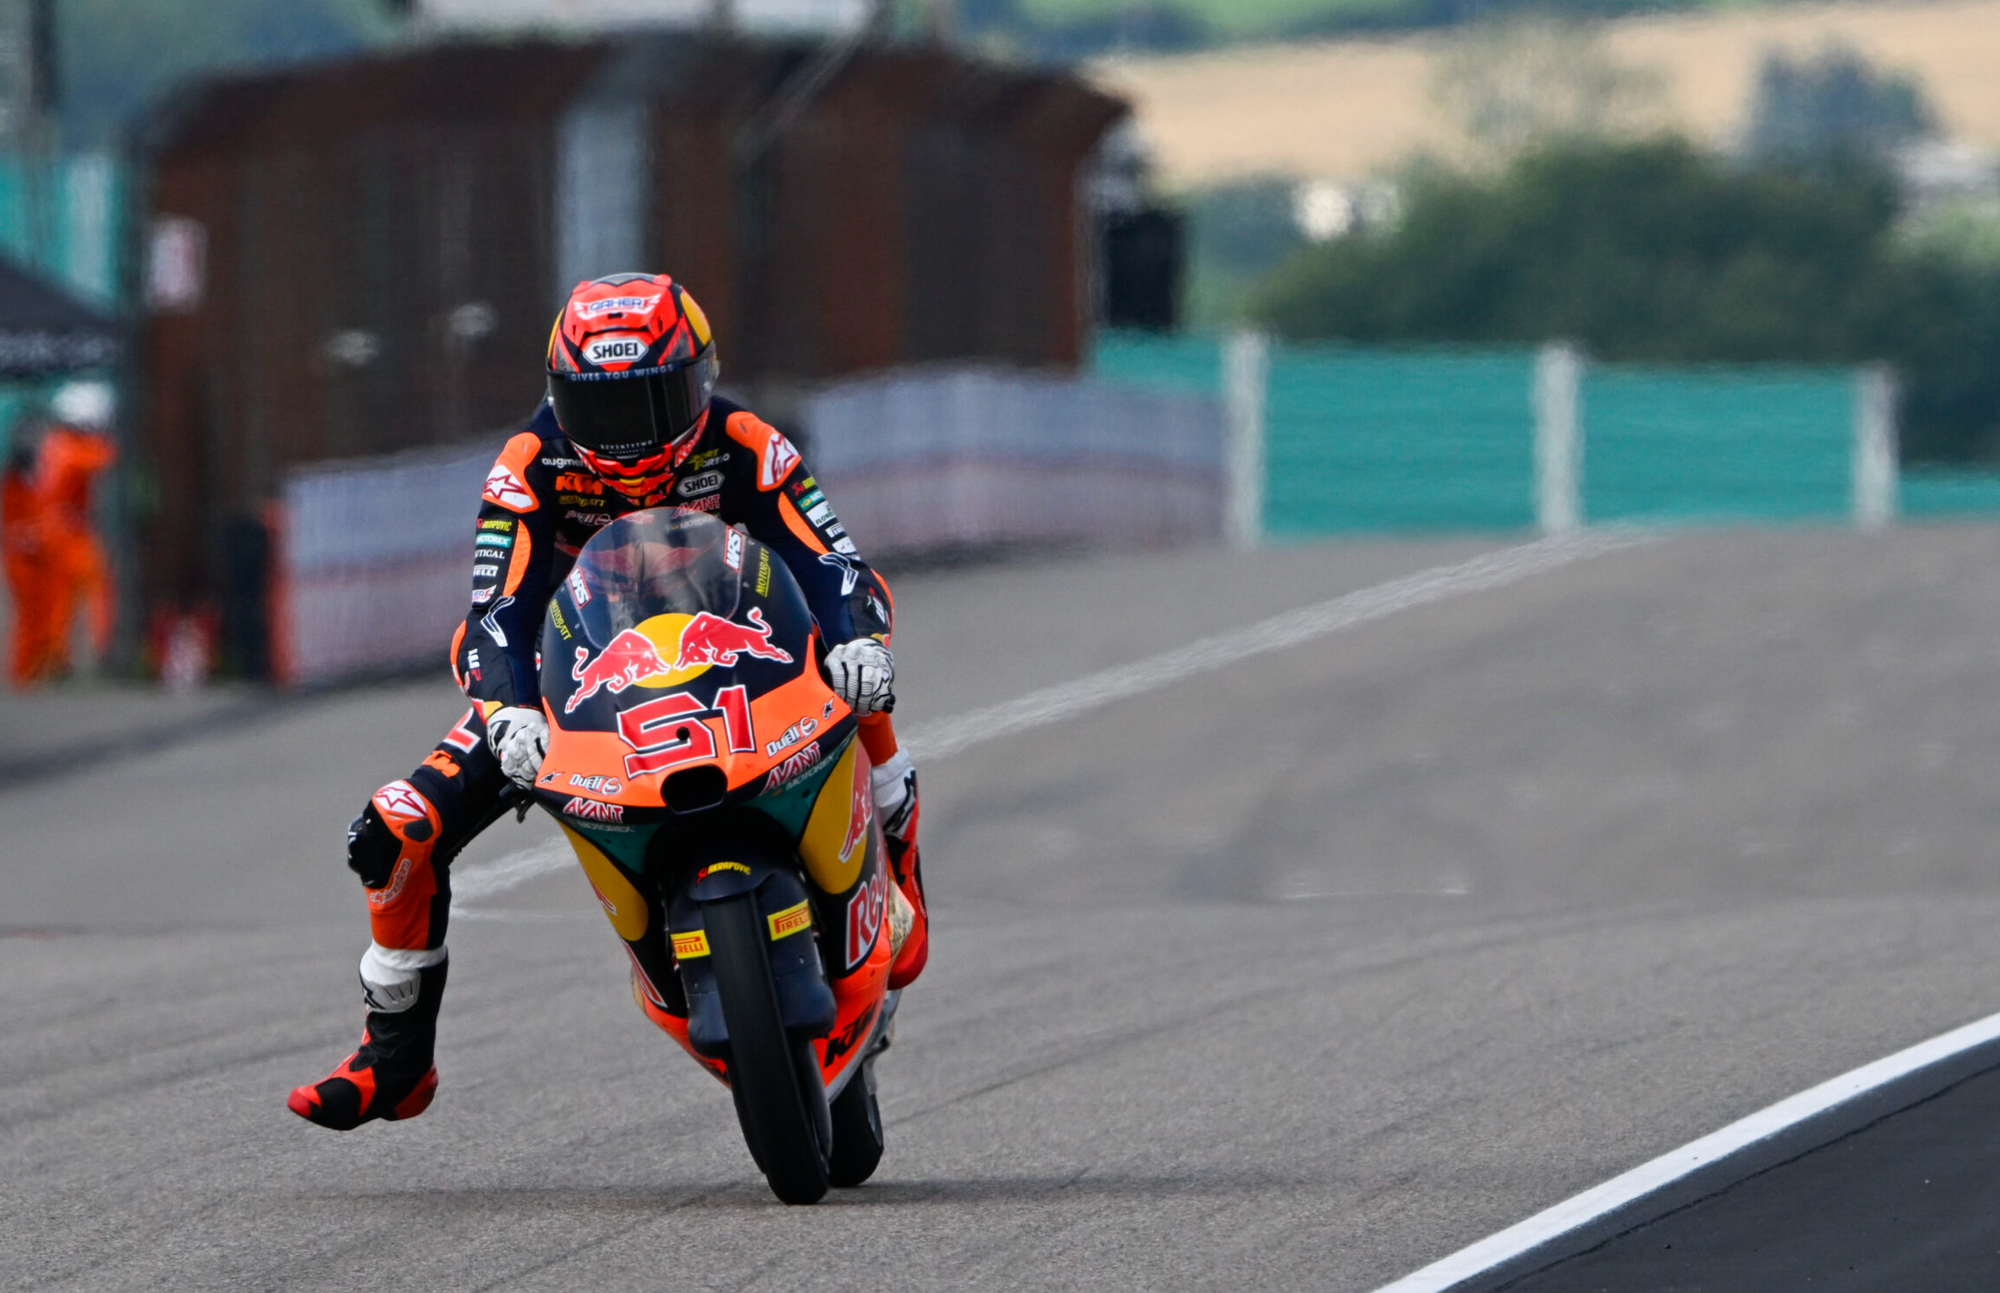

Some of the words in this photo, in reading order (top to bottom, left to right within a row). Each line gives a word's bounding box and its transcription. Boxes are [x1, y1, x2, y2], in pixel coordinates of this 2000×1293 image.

[592, 342, 639, 360] SHOEI
[570, 371, 600, 381] GIVES
[605, 370, 629, 379] YOU
[634, 363, 674, 376] WINGS
[541, 457, 588, 469] augmen
[555, 471, 604, 496] KTM
[683, 474, 719, 493] SHOEI
[671, 494, 720, 519] AVANT
[726, 528, 742, 570] WRS
[755, 546, 771, 598] MOTOBATT
[570, 567, 590, 605] WRS
[549, 598, 572, 640] MOTOBATT
[616, 685, 757, 780] 51
[759, 741, 821, 797] AVANT
[562, 796, 624, 823] AVANT
[673, 936, 704, 954] IRELLI
